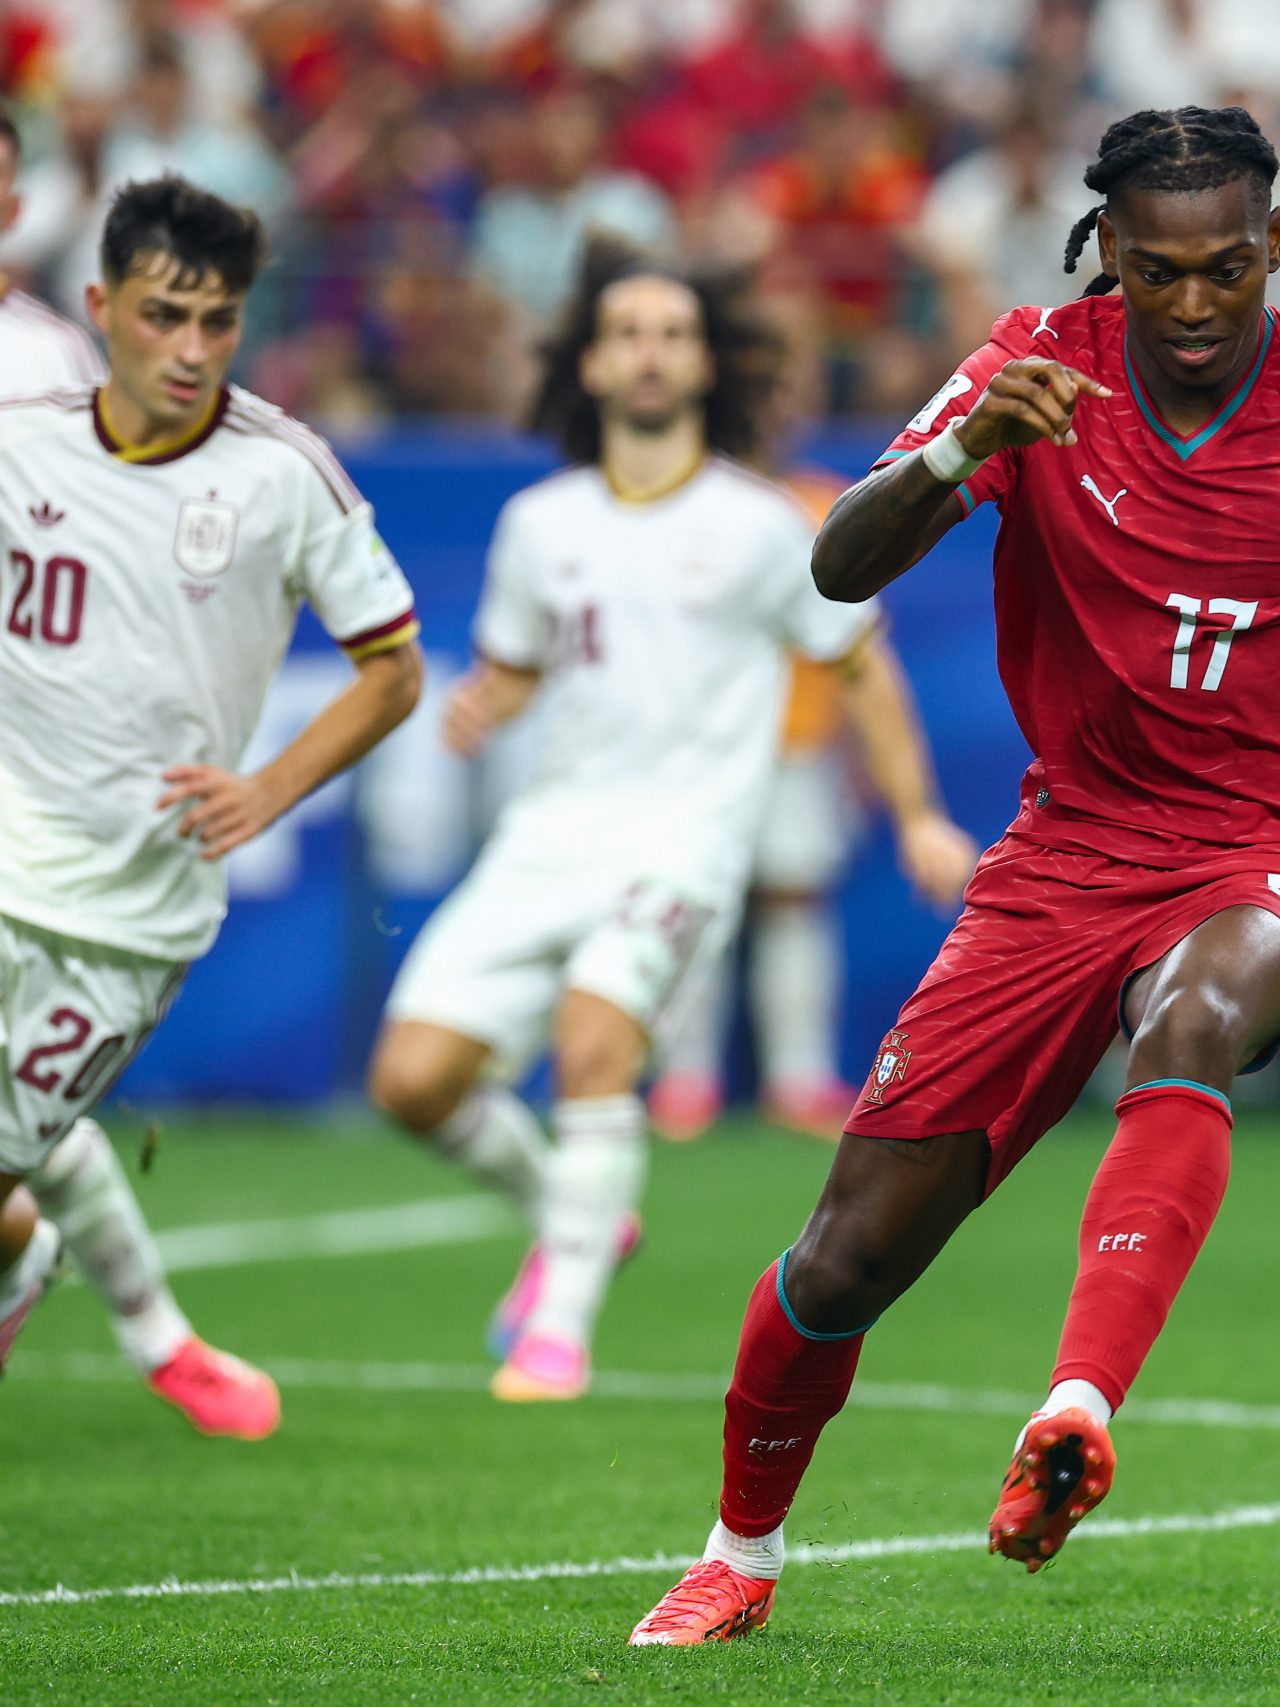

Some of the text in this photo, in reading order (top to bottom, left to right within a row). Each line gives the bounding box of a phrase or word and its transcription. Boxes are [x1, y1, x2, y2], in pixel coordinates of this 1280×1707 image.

[8, 548, 87, 647] 20
[1165, 592, 1259, 691] 17
[15, 1007, 128, 1100] 20
